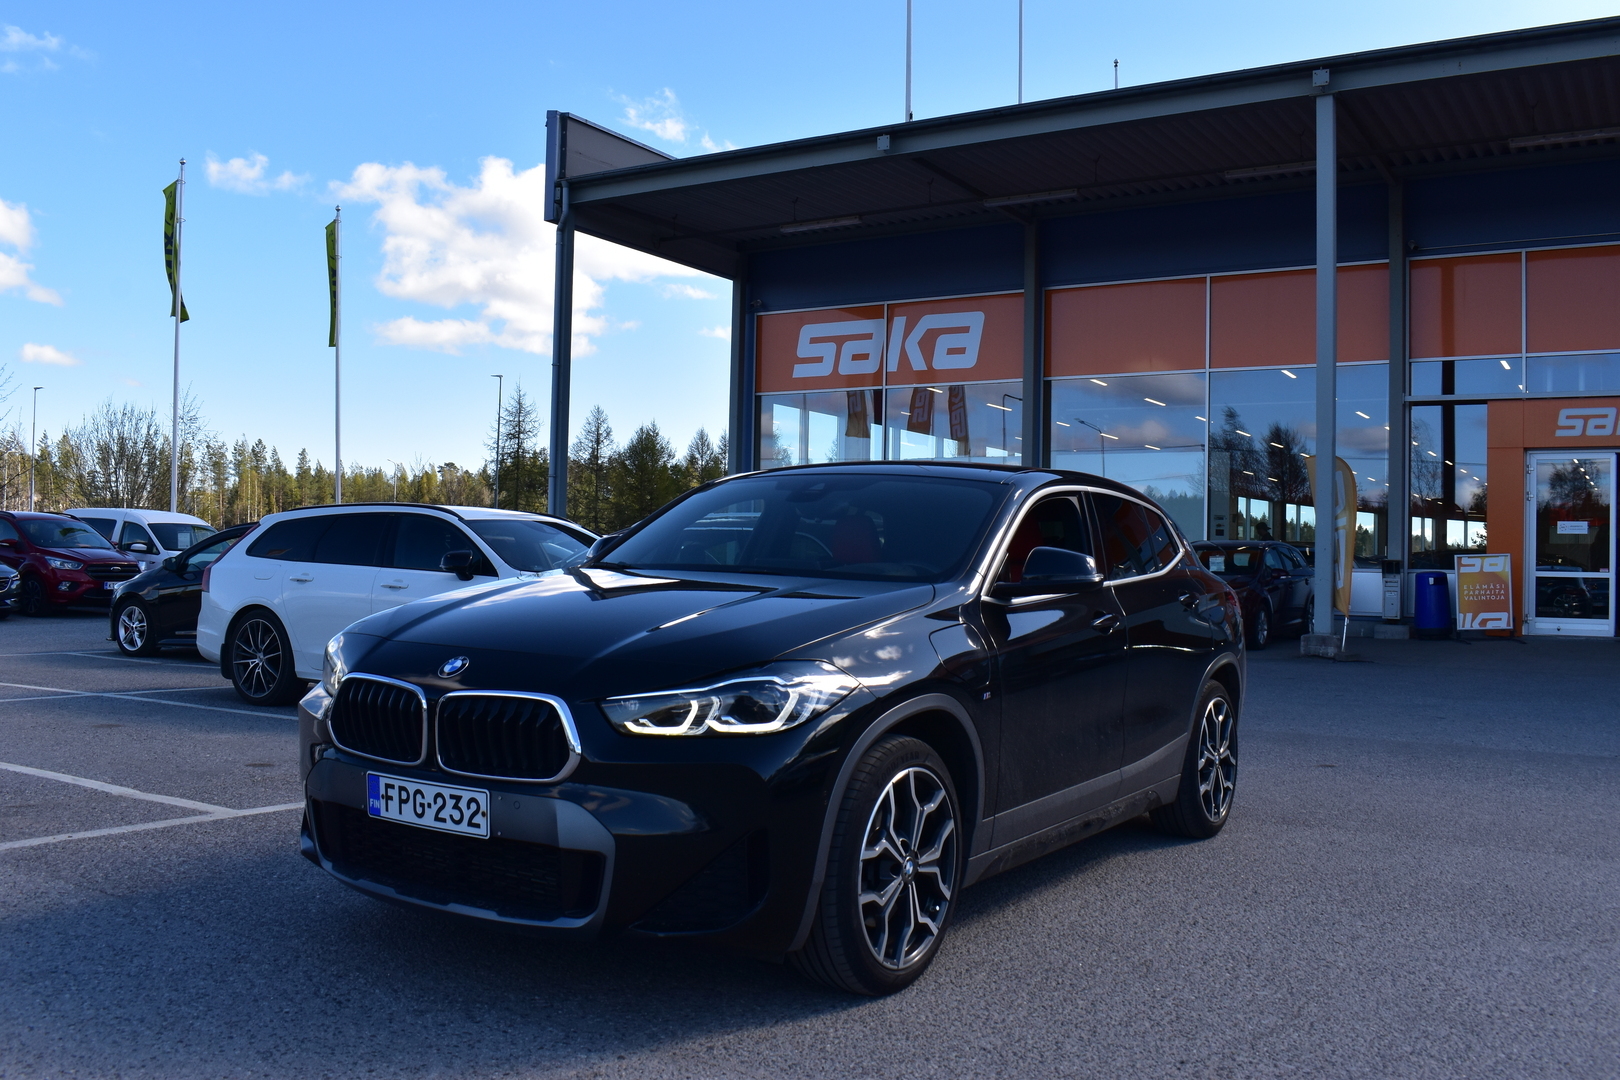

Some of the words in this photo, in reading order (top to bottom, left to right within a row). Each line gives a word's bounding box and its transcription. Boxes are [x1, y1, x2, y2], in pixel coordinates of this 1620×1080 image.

[1555, 407, 1620, 437] sa
[369, 798, 380, 809] FIN
[385, 783, 481, 828] FPG-232
